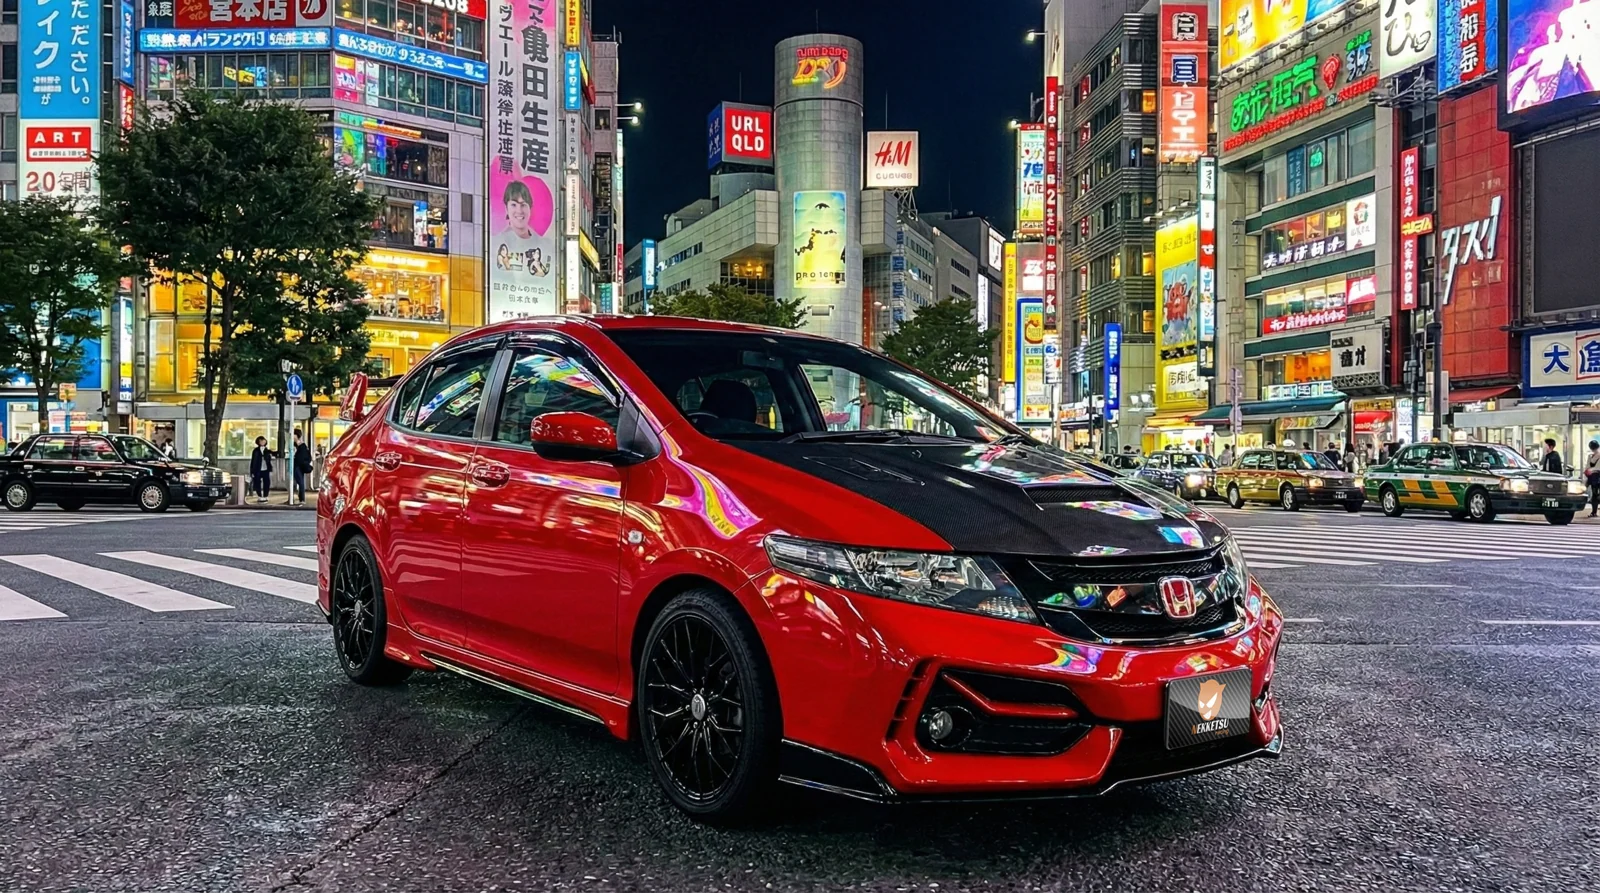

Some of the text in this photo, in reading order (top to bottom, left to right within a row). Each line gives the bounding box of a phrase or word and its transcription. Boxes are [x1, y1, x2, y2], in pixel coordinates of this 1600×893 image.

[731, 115, 764, 133] URL
[34, 131, 82, 143] ART
[1191, 718, 1230, 735] NEKKETSU
